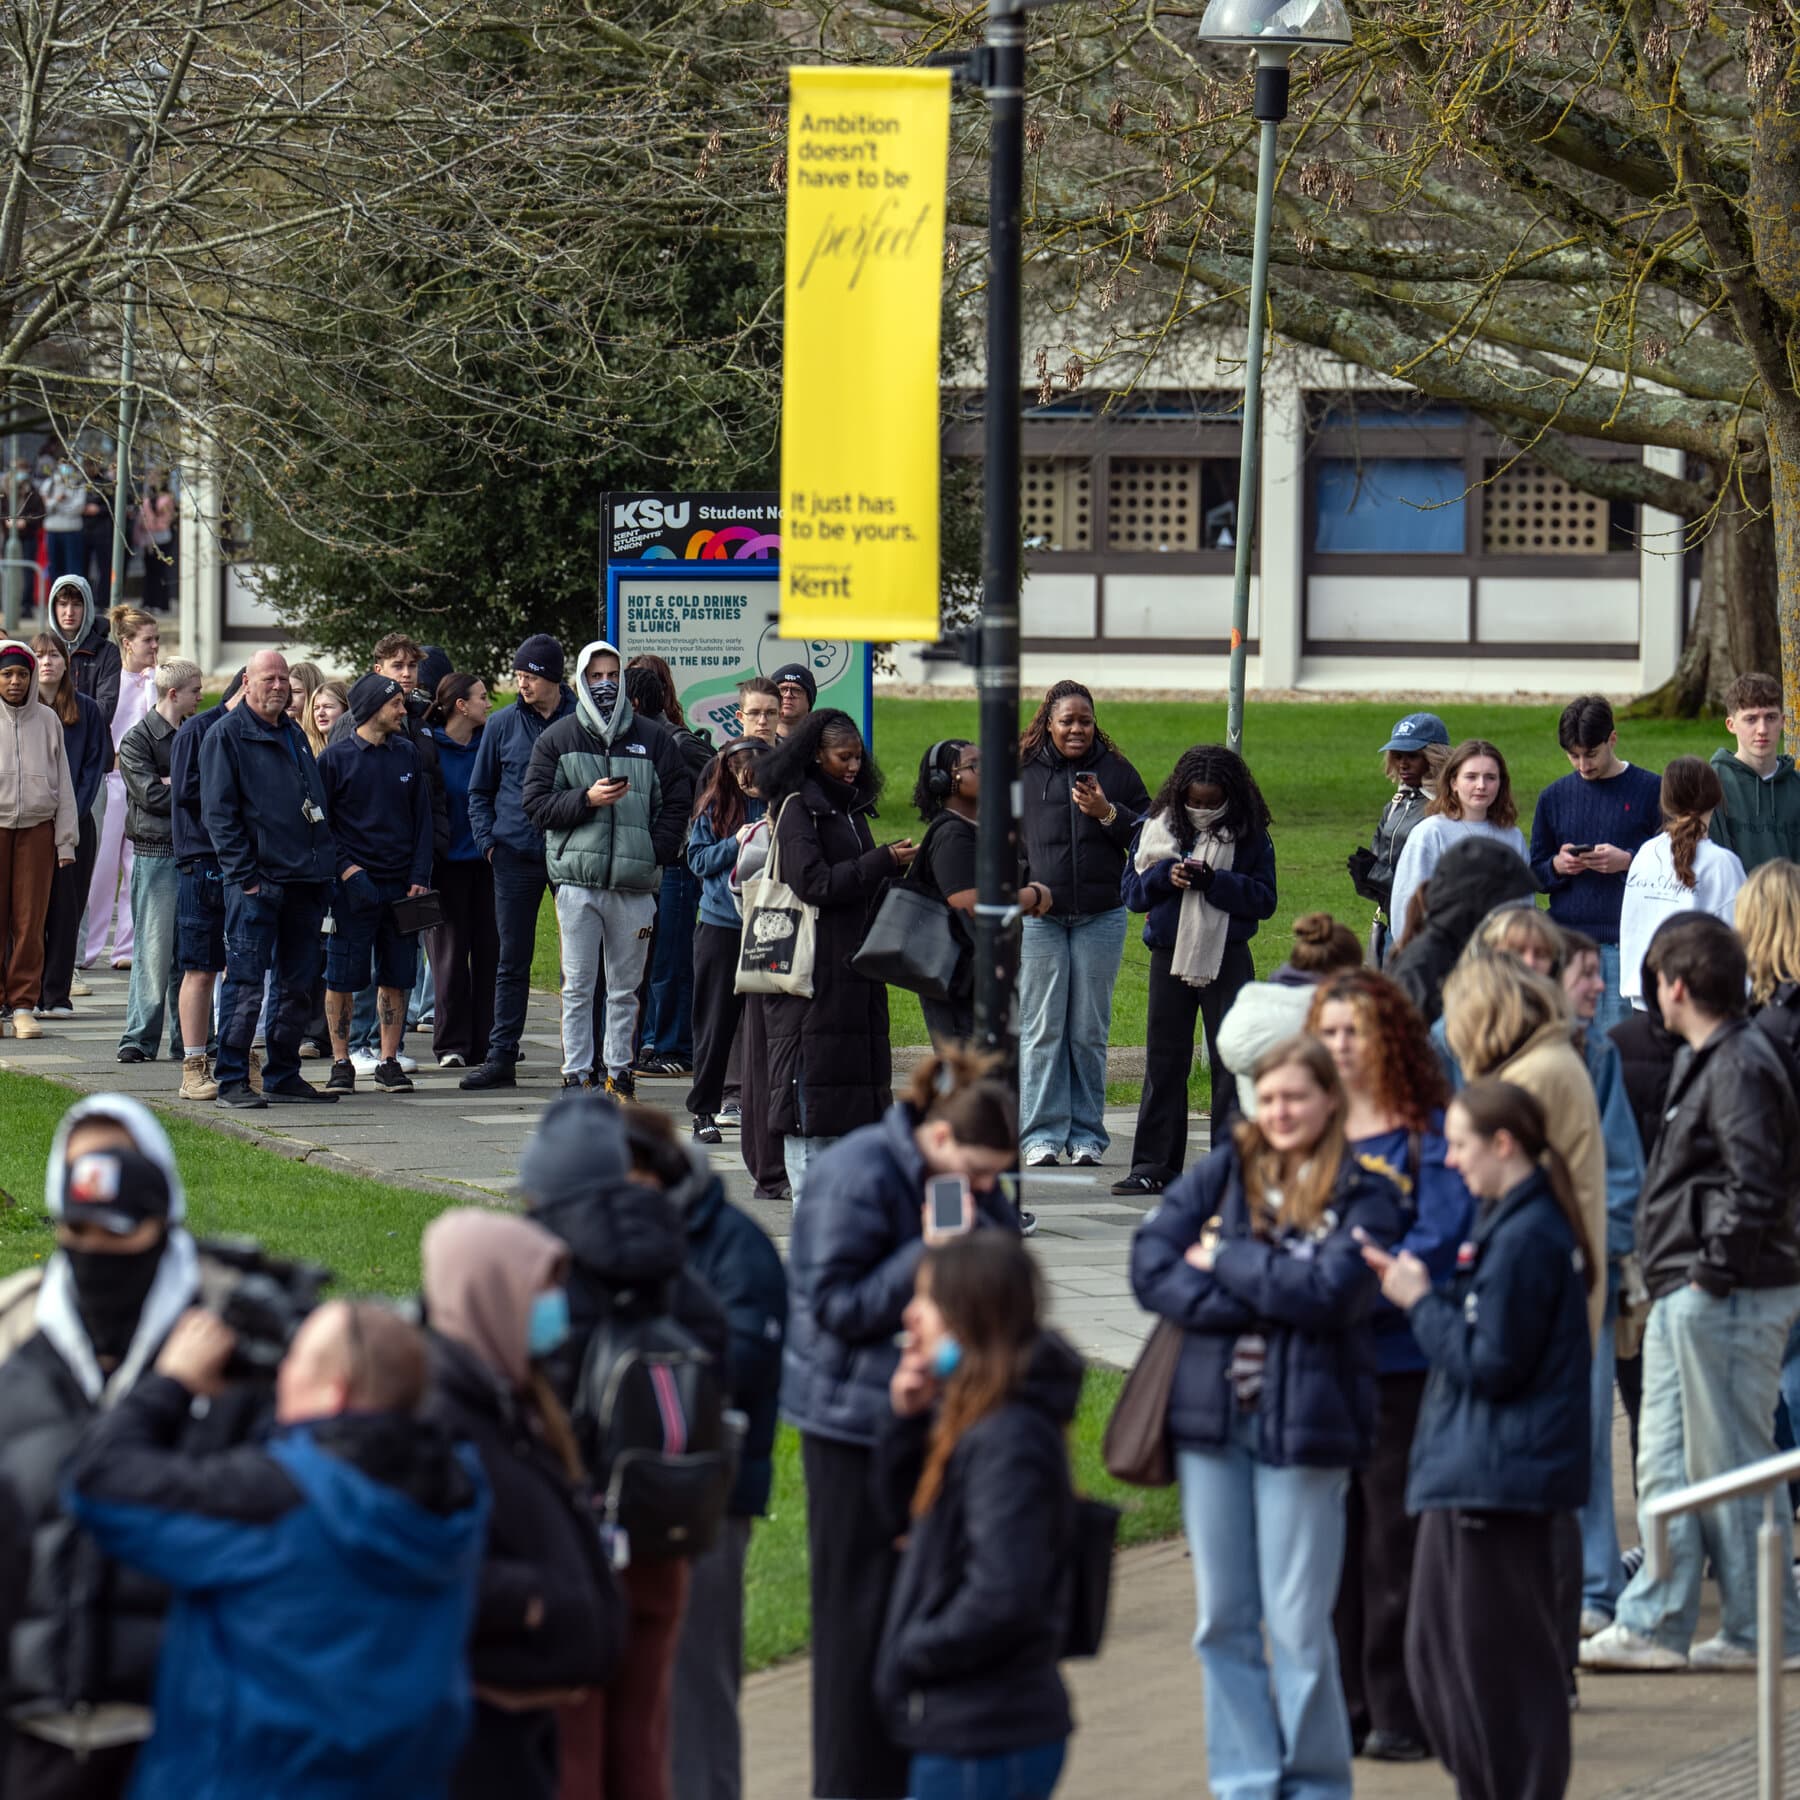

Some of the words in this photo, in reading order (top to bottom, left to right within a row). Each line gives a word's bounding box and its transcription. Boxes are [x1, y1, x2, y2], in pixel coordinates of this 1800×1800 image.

[800, 113, 900, 135] Ambition
[798, 141, 877, 161] doesn't
[798, 167, 850, 188] have
[857, 170, 878, 188] to
[884, 169, 909, 188] be
[798, 195, 931, 290] perfect
[790, 492, 805, 513] It
[811, 492, 851, 517] just
[859, 493, 896, 513] has
[614, 499, 690, 529] KSU
[699, 506, 764, 519] Student
[614, 529, 640, 541] KENT
[791, 520, 813, 540] to
[819, 520, 846, 540] be
[852, 523, 919, 545] yours.
[614, 541, 642, 552] UNION
[790, 573, 852, 599] Kent
[628, 595, 651, 607] HOT
[656, 595, 664, 607] &
[669, 595, 699, 607] COLD
[704, 595, 747, 607] DRINKS
[683, 608, 741, 619] PASTRIES
[628, 621, 636, 632] &
[641, 621, 680, 632] LUNCH
[627, 638, 644, 646] Open
[671, 645, 679, 653] by
[680, 656, 698, 666] THE
[701, 656, 719, 666] KSU
[722, 656, 741, 666] APP
